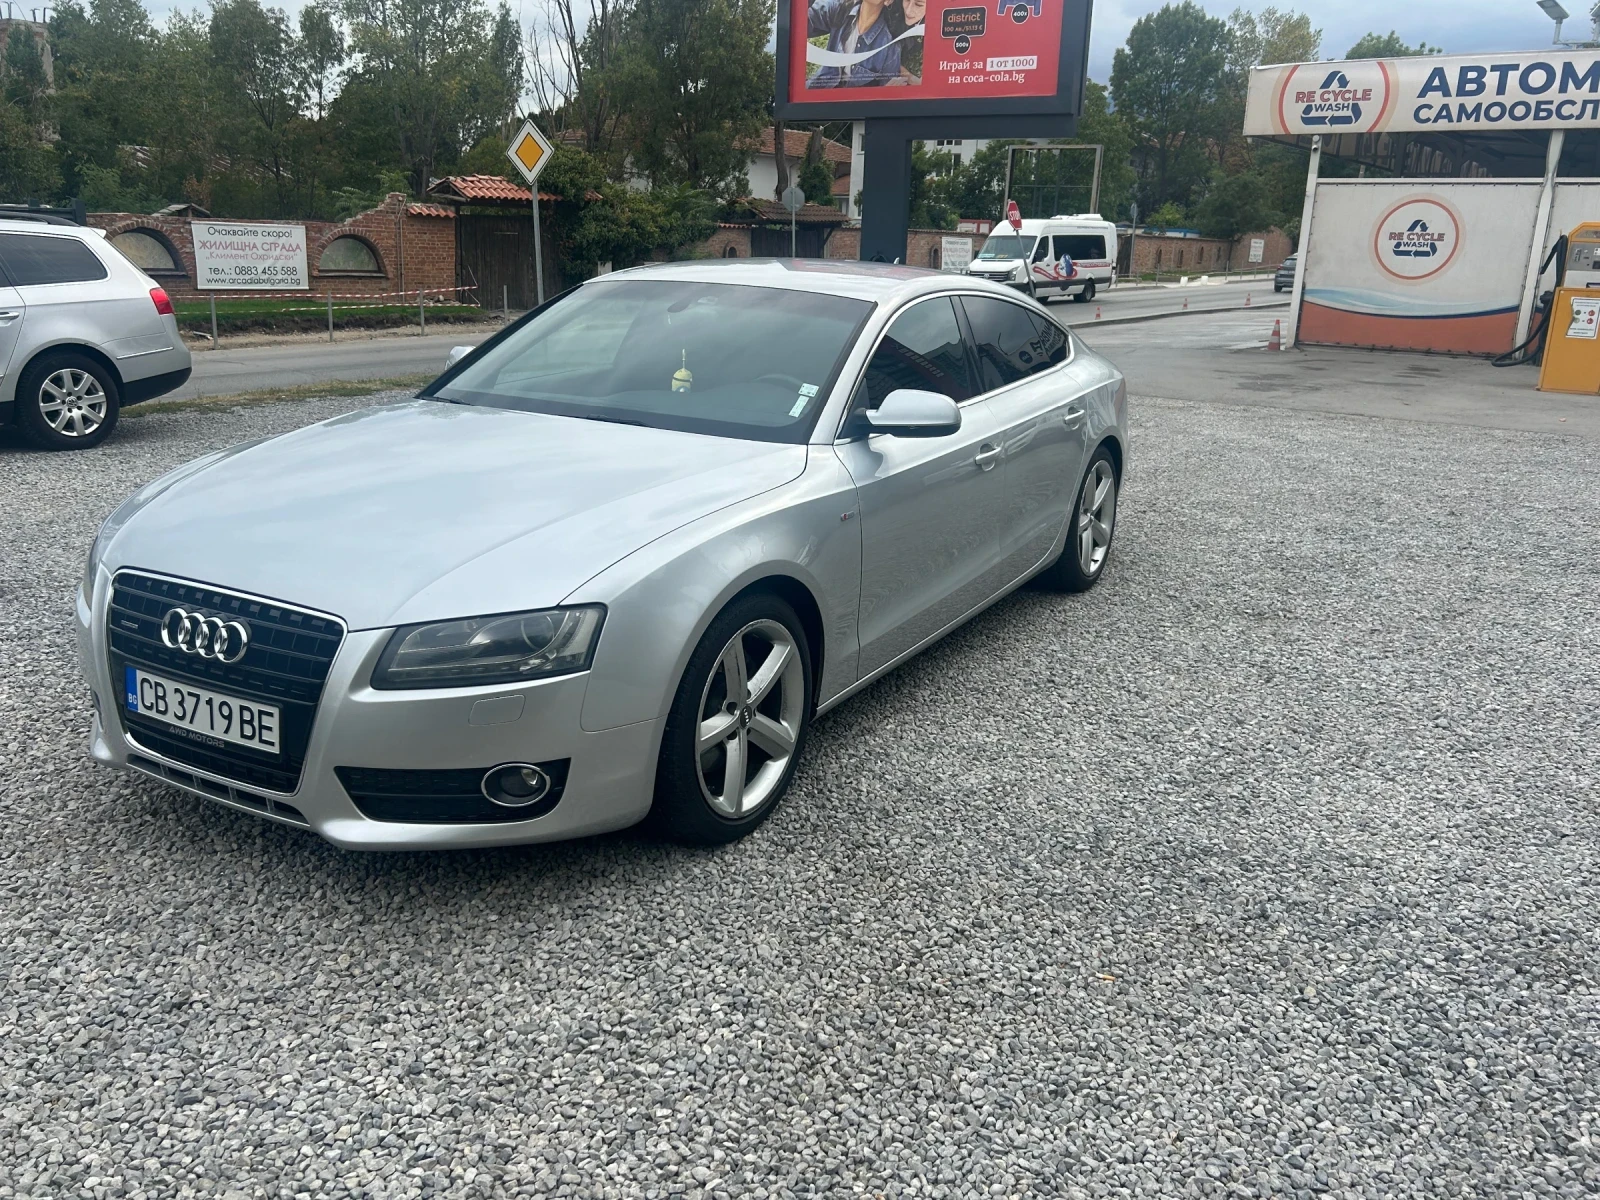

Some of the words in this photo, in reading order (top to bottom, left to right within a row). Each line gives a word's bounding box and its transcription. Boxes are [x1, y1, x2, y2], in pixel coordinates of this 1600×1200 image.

[947, 12, 981, 23] district
[939, 59, 970, 72] Играй
[972, 61, 984, 69] за
[989, 60, 995, 68] 1
[1010, 58, 1035, 68] 1000
[948, 75, 961, 84] на
[962, 71, 1026, 84] coca-cola.bg
[1416, 60, 1600, 98] АВТОМ
[1295, 90, 1317, 103] RE
[1319, 88, 1373, 103] CYCLE
[1313, 103, 1351, 112] WASH
[1413, 99, 1600, 124] САМООБСЛ
[207, 226, 259, 237] Очаквайте
[261, 229, 293, 239] скоро!
[1388, 232, 1405, 241] RE
[1406, 232, 1446, 242] CYCLE
[199, 240, 259, 252] ЖИЛИЩНА
[261, 242, 302, 252] СГРАДА
[205, 252, 249, 260] „Климент
[208, 267, 232, 275] тел.:
[234, 266, 259, 275] 0883
[261, 266, 279, 276] 455
[280, 266, 298, 276] 588
[206, 277, 301, 285] www.arcadiabulgaria.bg
[128, 693, 138, 705] BG
[169, 726, 188, 737] AWD
[188, 731, 225, 748] MOTORS
